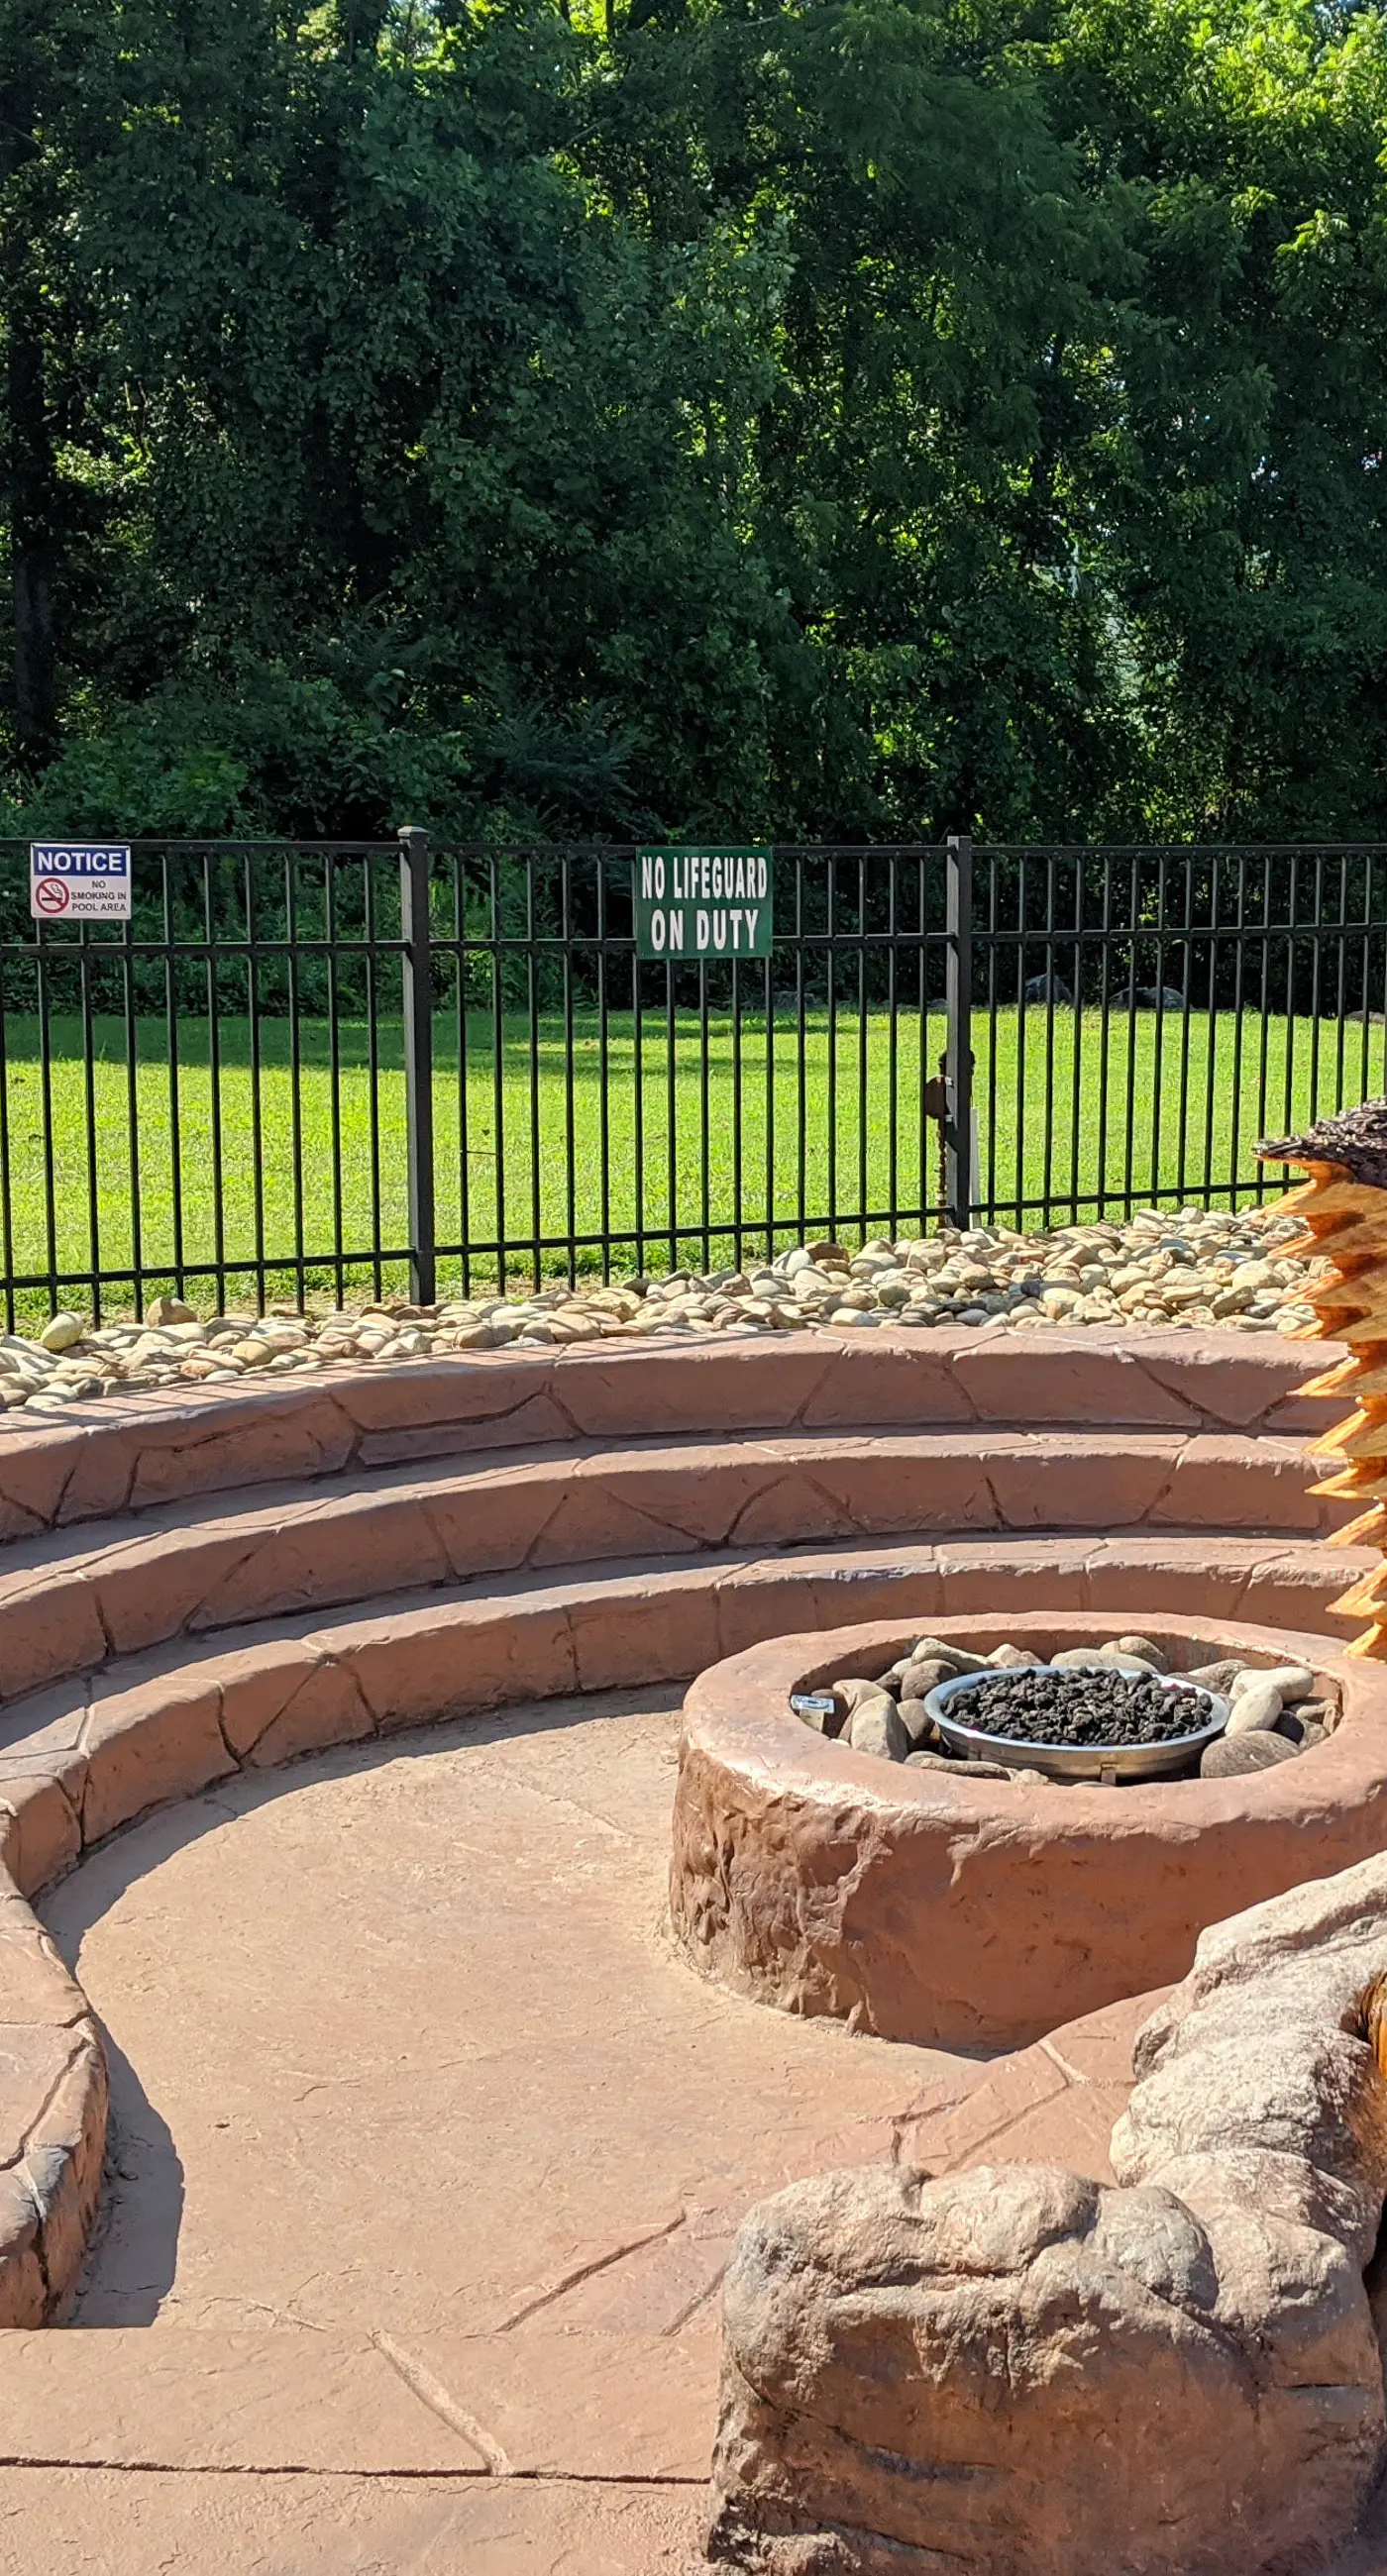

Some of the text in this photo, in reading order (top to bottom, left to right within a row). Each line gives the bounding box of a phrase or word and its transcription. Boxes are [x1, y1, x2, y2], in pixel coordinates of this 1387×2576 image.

[38, 851, 123, 872] NOTICE
[91, 879, 106, 888] NO
[642, 856, 768, 899] NO LIFEGUARD
[70, 891, 127, 900] SMOKING IN
[71, 902, 127, 912] POOL AREA
[651, 909, 759, 951] ON DUTY
